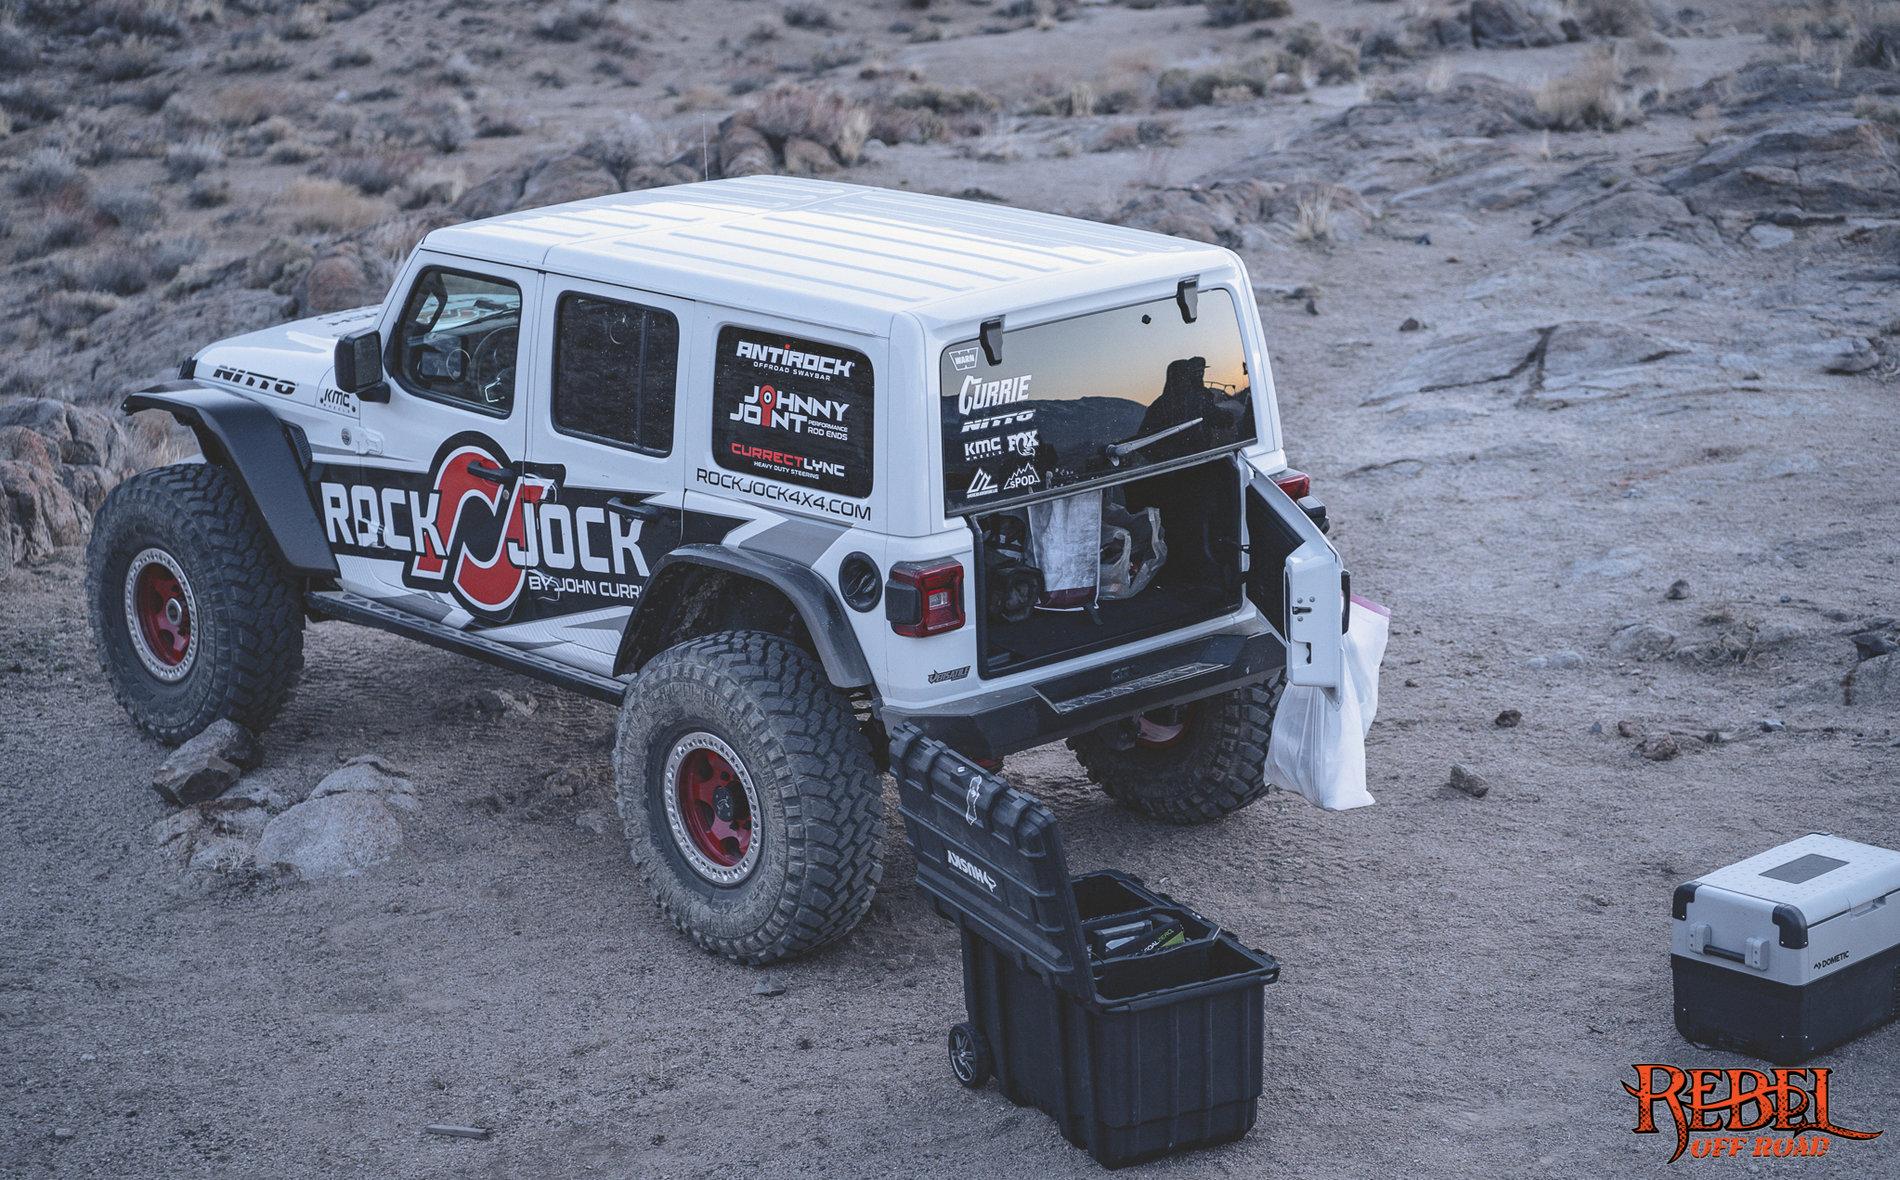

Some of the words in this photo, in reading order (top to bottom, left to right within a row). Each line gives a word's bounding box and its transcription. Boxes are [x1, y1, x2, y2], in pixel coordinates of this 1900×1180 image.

[736, 341, 852, 377] ANTIROCK
[753, 362, 790, 373] OFFROAD
[793, 368, 831, 382] SWAYBAR
[213, 365, 296, 396] NITTO
[324, 388, 350, 408] KMC
[744, 384, 850, 421] JOHNNY
[958, 374, 1032, 416] CURRIE
[730, 402, 808, 433] JOINT
[808, 419, 848, 433] PERFORMANCE
[961, 409, 1036, 433] NITTO
[808, 426, 825, 436] ROD
[826, 430, 848, 441] ENDS
[964, 437, 1002, 456] KMC
[1007, 430, 1039, 456] FOX
[731, 443, 845, 477] CURRECTLYNC
[753, 461, 773, 470] HEAVY
[774, 465, 790, 474] DUTY
[791, 469, 820, 480] STEERING
[696, 468, 872, 521] ROCKJOCK4X4.COM
[320, 482, 448, 556] ROCK
[506, 502, 650, 577] JOCK
[529, 576, 553, 591] BY
[554, 577, 597, 595] JOHN
[947, 850, 985, 884] HUSKY
[1822, 950, 1849, 968] DOMETIC
